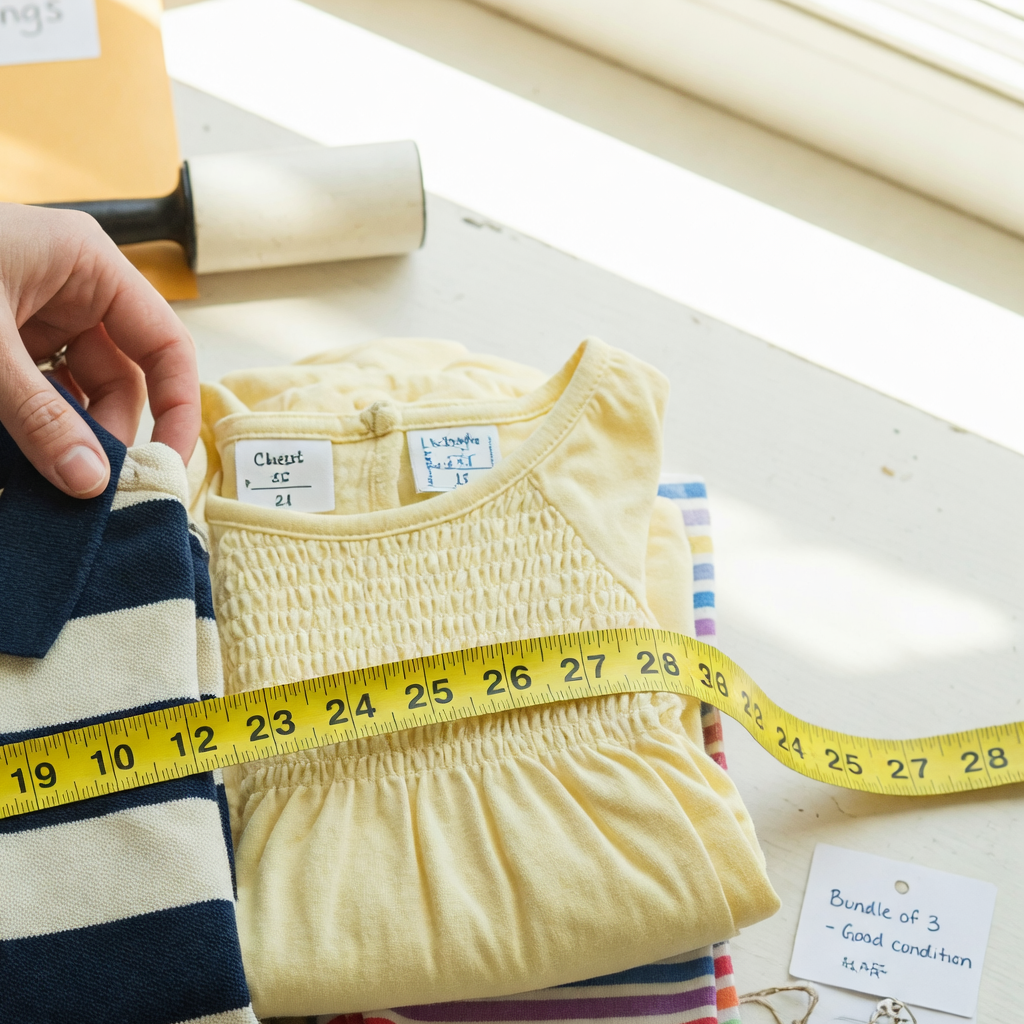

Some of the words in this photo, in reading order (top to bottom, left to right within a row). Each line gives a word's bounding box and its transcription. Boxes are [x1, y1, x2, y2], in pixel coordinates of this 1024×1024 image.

[11, 762, 58, 794] 19
[90, 744, 135, 776] 10
[171, 726, 217, 758] 12
[245, 709, 297, 743] 23
[325, 692, 376, 726] 24
[404, 677, 454, 710] 25
[482, 664, 532, 696] 26
[559, 653, 606, 682] 27
[635, 650, 680, 677] 28
[776, 726, 805, 760] 24
[825, 748, 863, 775] 25
[886, 758, 929, 779] 27
[960, 747, 1009, 773] 28
[830, 888, 892, 920] Bundle
[900, 909, 920, 925] of
[927, 915, 940, 932] 3
[842, 923, 884, 948] Good
[891, 940, 973, 970] condition
